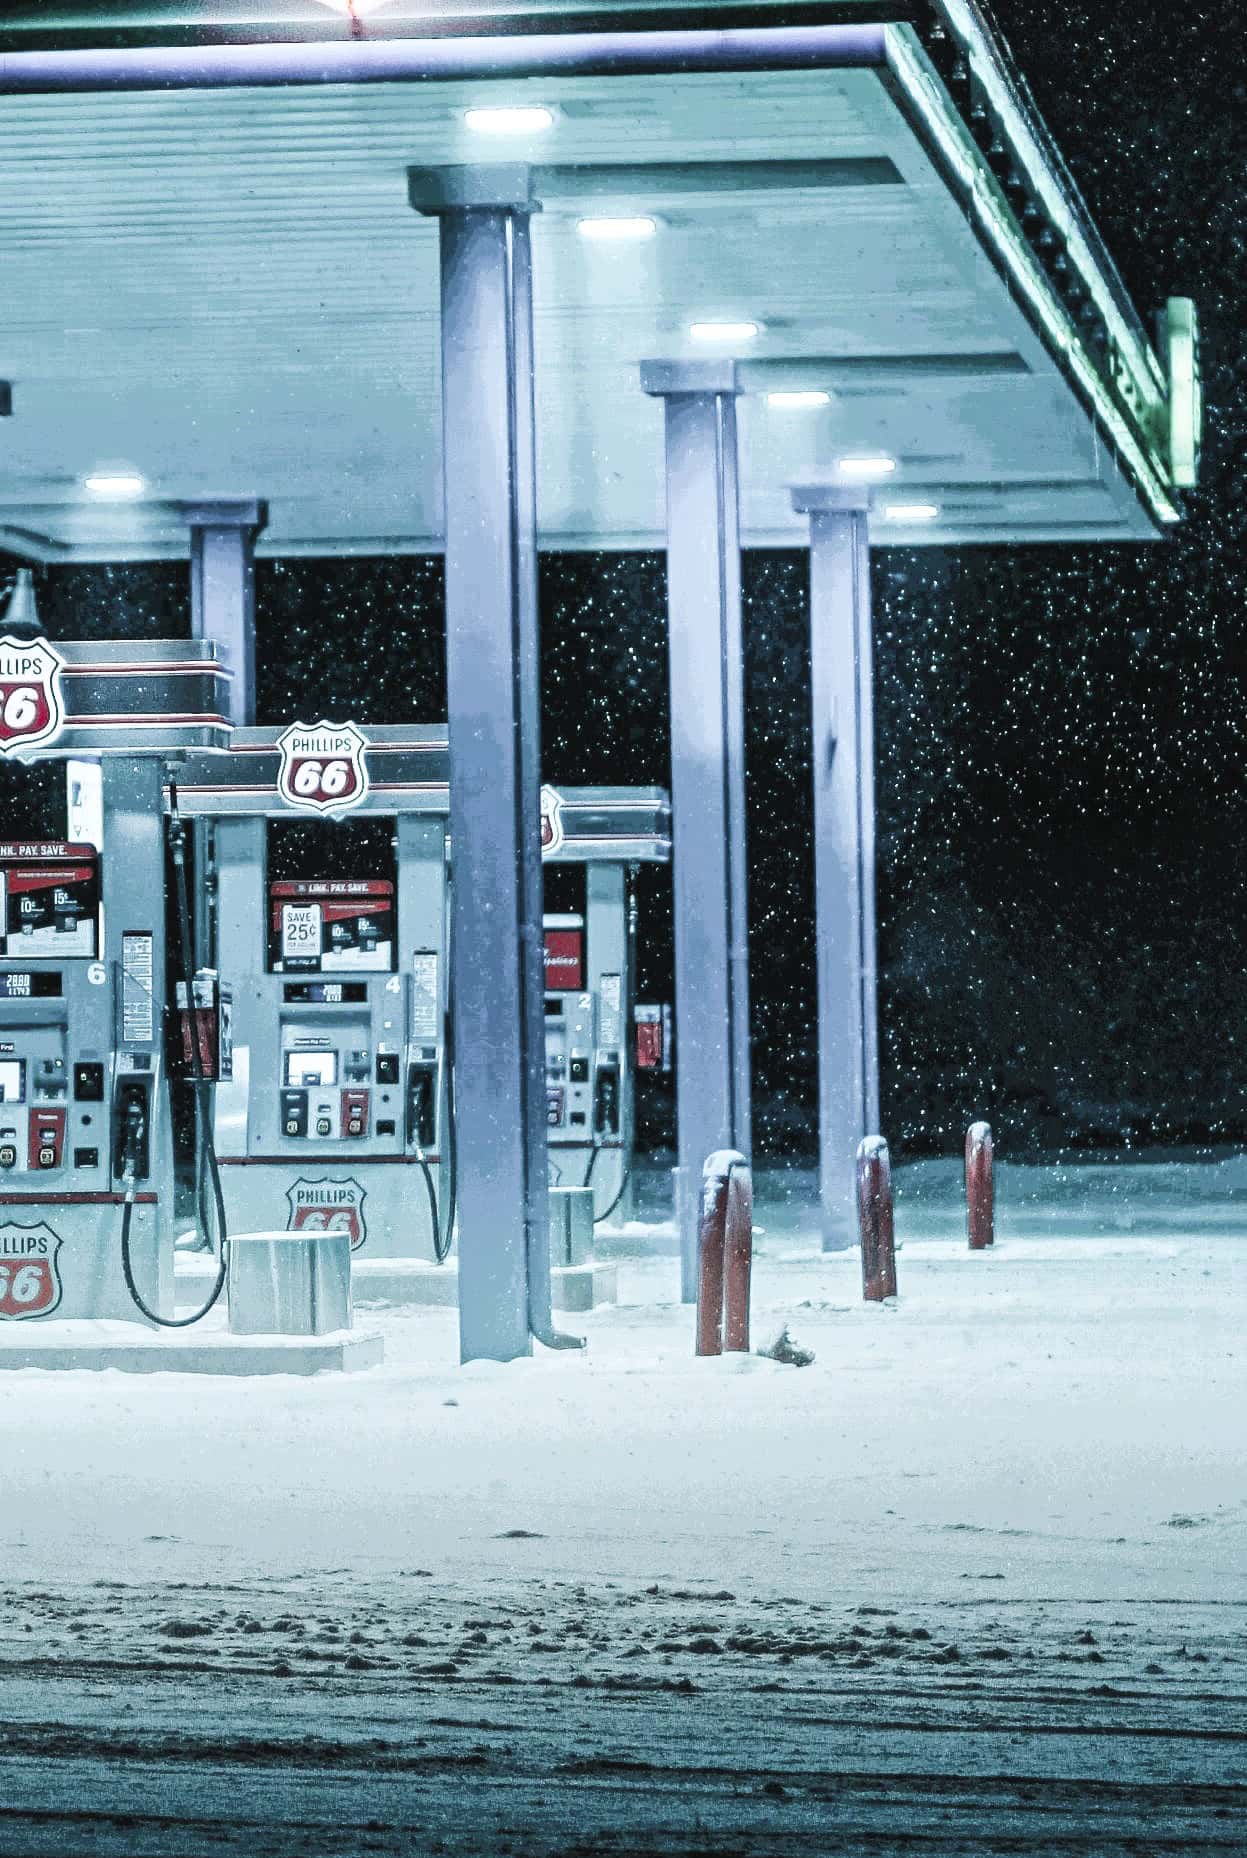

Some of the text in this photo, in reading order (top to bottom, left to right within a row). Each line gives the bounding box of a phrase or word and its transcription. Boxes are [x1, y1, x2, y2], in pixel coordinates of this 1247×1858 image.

[292, 738, 352, 752] PHILLIPS
[295, 761, 349, 795] 66
[287, 912, 311, 922] SAVE
[287, 924, 317, 941] 25¢
[87, 963, 106, 985] 6
[385, 975, 401, 994] 4
[578, 993, 592, 1009] 2
[297, 1190, 355, 1203] PHILLIPS
[302, 1211, 352, 1231] 66
